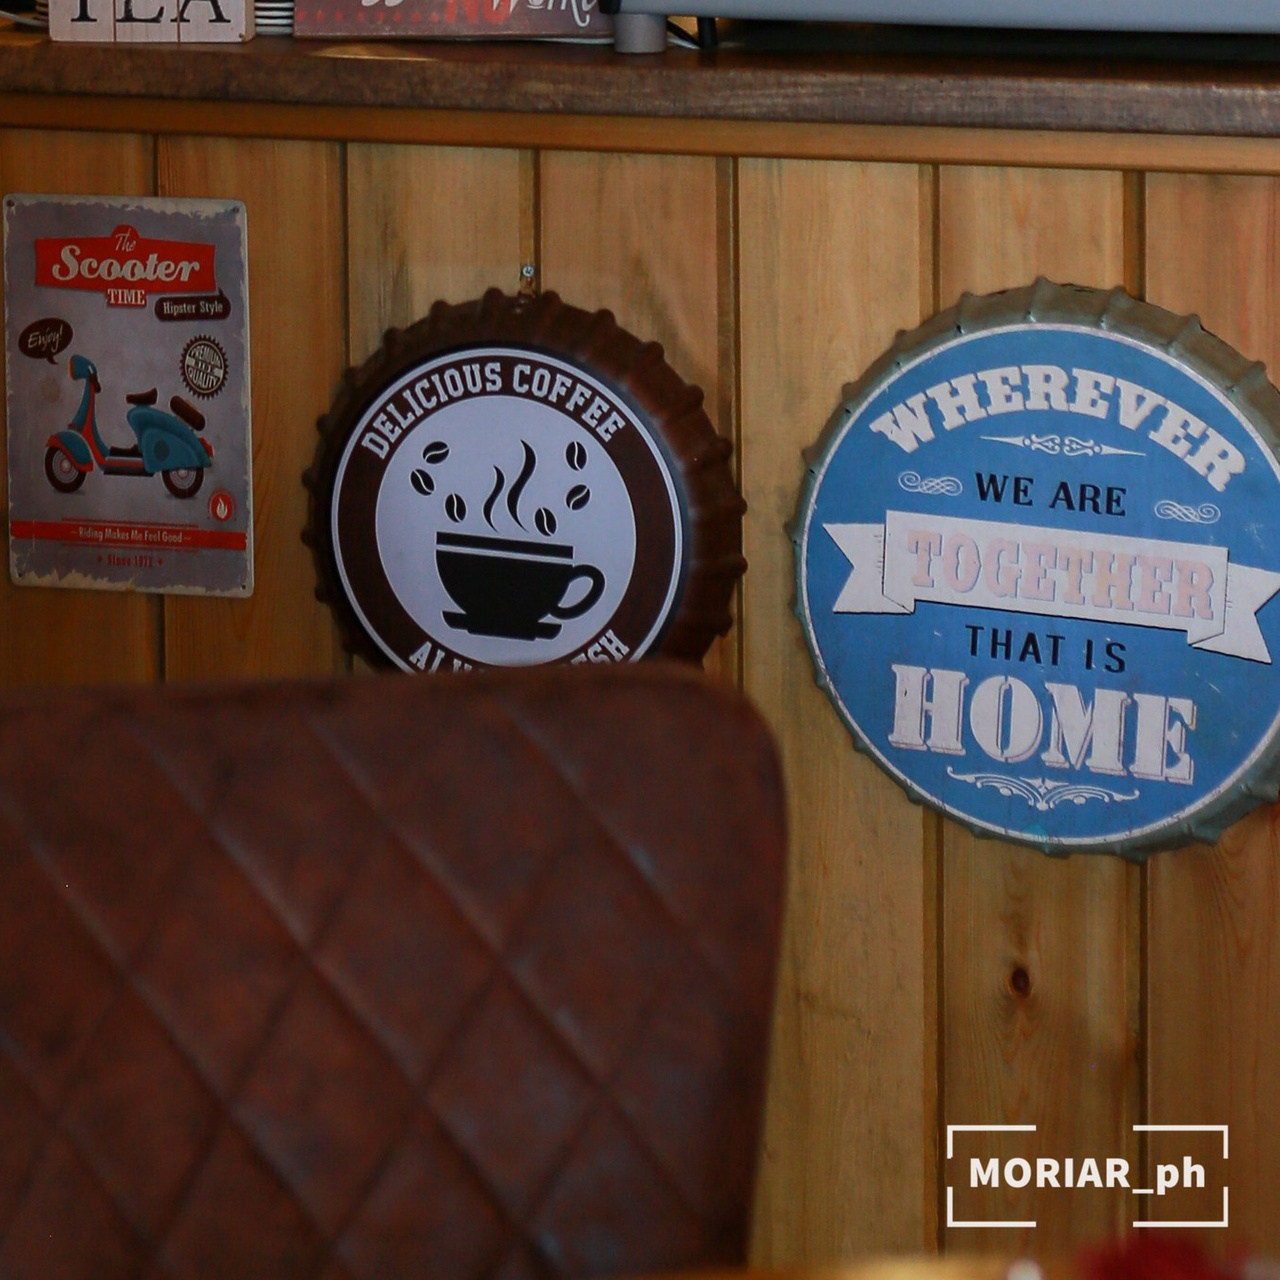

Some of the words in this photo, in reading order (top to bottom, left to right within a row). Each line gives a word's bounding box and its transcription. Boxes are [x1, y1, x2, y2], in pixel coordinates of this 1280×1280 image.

[115, 229, 136, 252] The
[51, 244, 201, 282] Scooter
[107, 288, 146, 305] TIME
[163, 301, 196, 317] Hipster
[199, 299, 224, 316] Style
[27, 324, 63, 351] Enjoy!
[188, 367, 218, 388] QUALITY
[361, 362, 503, 459] DELICIOUS
[512, 363, 627, 443] COFFEE
[869, 364, 1248, 493] WHEREVER
[974, 472, 1034, 506] WE
[1048, 480, 1128, 517] ARE
[78, 526, 103, 542] Riding
[105, 528, 129, 540] Makes
[144, 530, 160, 542] Feel
[161, 531, 183, 543] Good
[906, 529, 1215, 621] TOGETHER
[965, 625, 1067, 667] THAT
[1085, 638, 1128, 674] IS
[888, 664, 1198, 786] HOME
